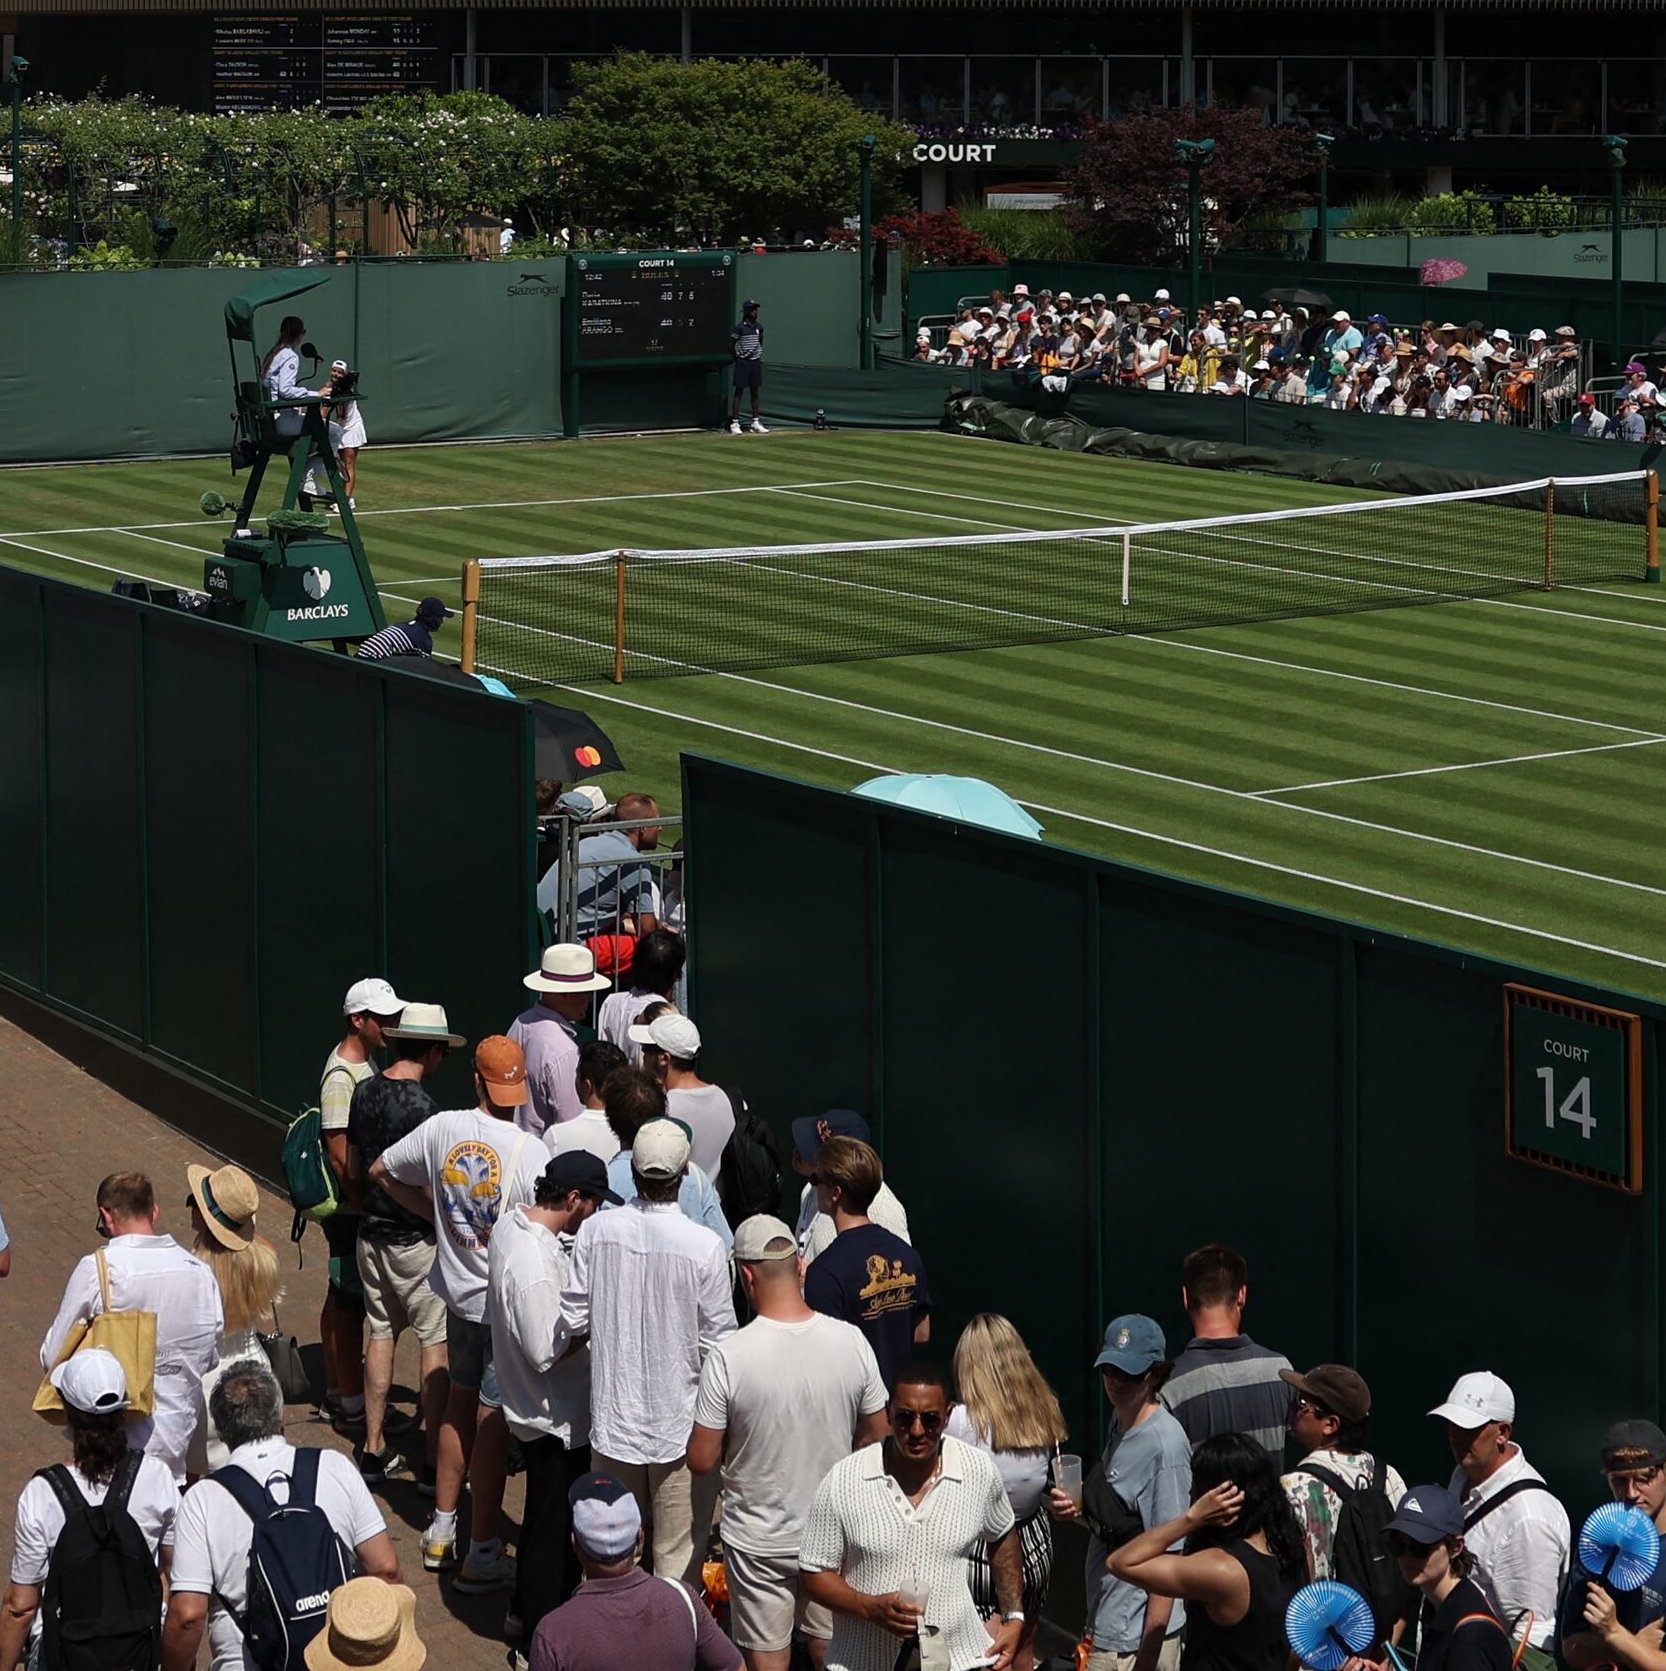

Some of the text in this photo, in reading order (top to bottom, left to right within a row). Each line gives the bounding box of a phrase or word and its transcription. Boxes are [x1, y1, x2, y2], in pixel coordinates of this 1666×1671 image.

[912, 144, 996, 162] COURT
[639, 260, 665, 268] COURT
[507, 286, 559, 297] Slazenger
[209, 576, 228, 590] evian
[287, 604, 349, 621] BARCLAYS
[1544, 1039, 1590, 1063] COURT
[1536, 1066, 1597, 1140] 14
[452, 1144, 476, 1160] LOVELY
[296, 1590, 330, 1612] arena
